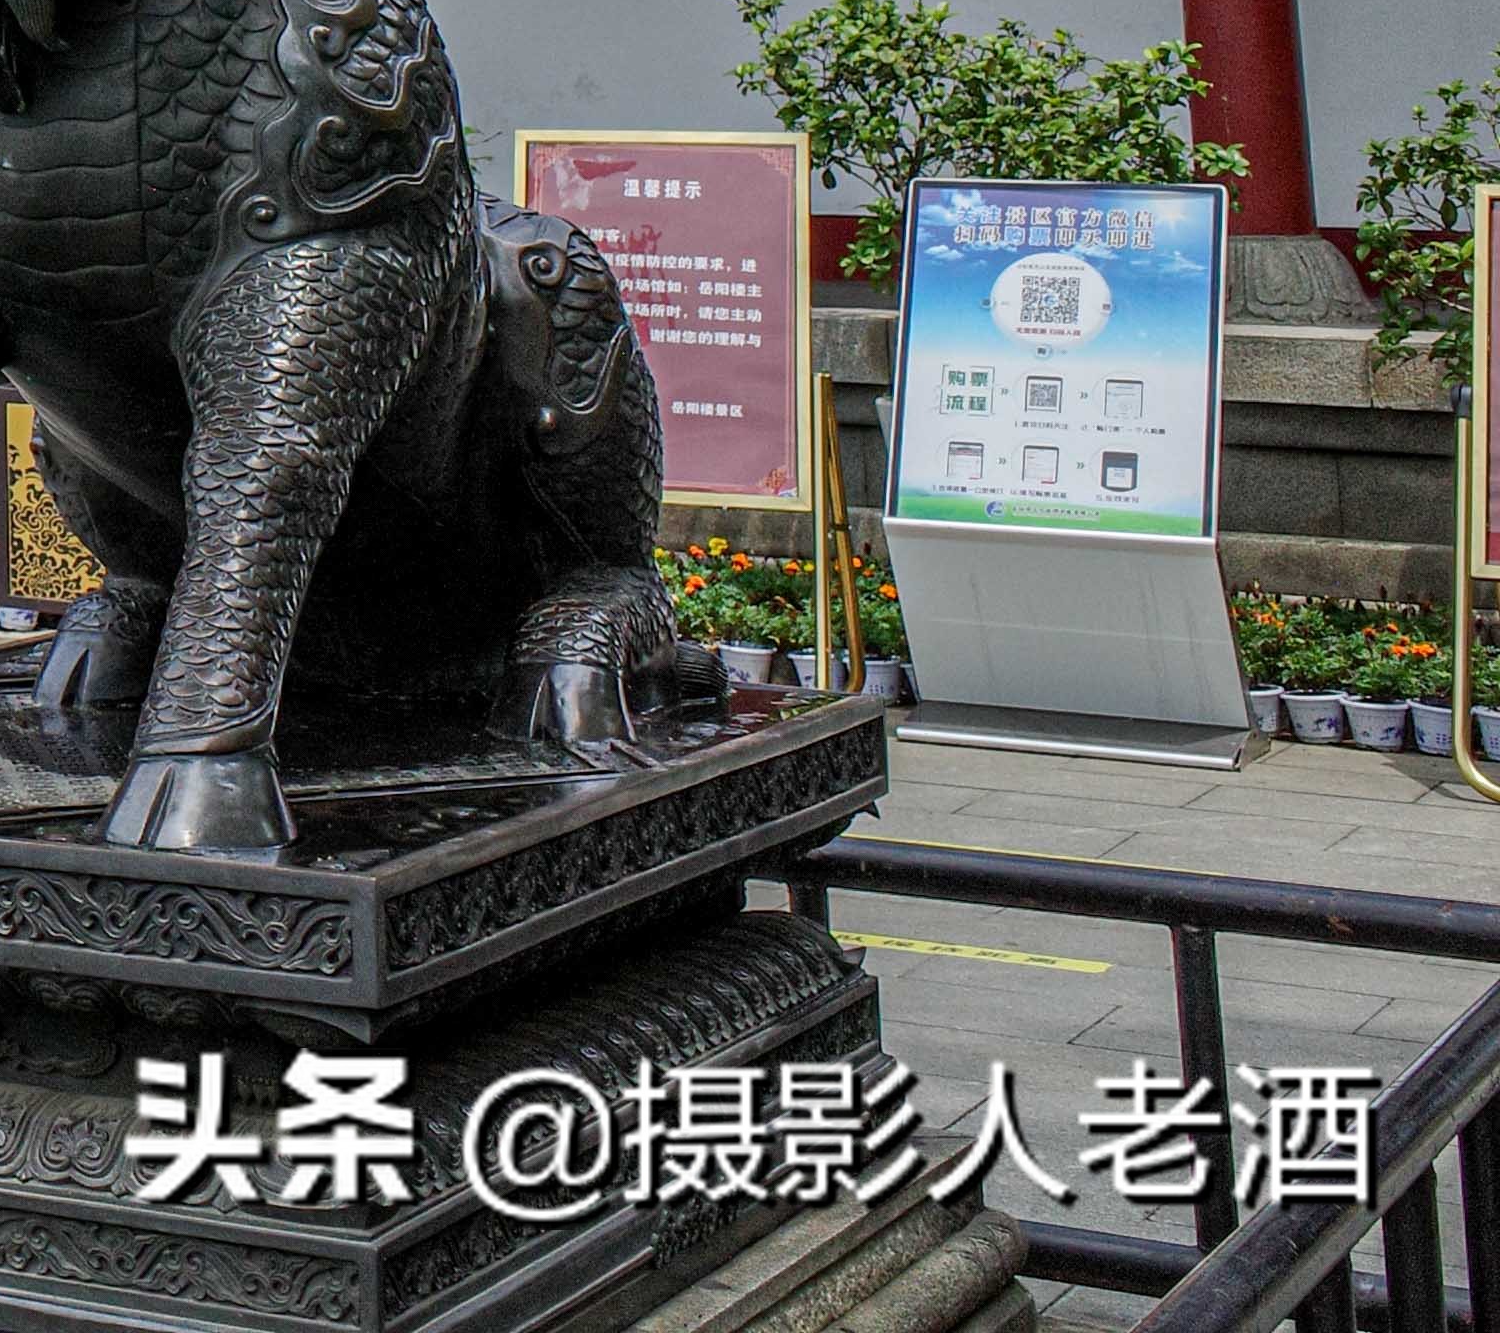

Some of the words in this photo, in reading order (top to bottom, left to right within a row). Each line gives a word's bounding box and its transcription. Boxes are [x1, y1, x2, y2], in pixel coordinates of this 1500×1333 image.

[623, 177, 703, 200] 温馨提示
[955, 205, 1155, 229] 关注景区官方微信
[650, 329, 762, 349] 谢谢您的理解与
[948, 370, 988, 387] 购票
[671, 400, 743, 419] 岳阳楼景区
[946, 395, 987, 412] 流程
